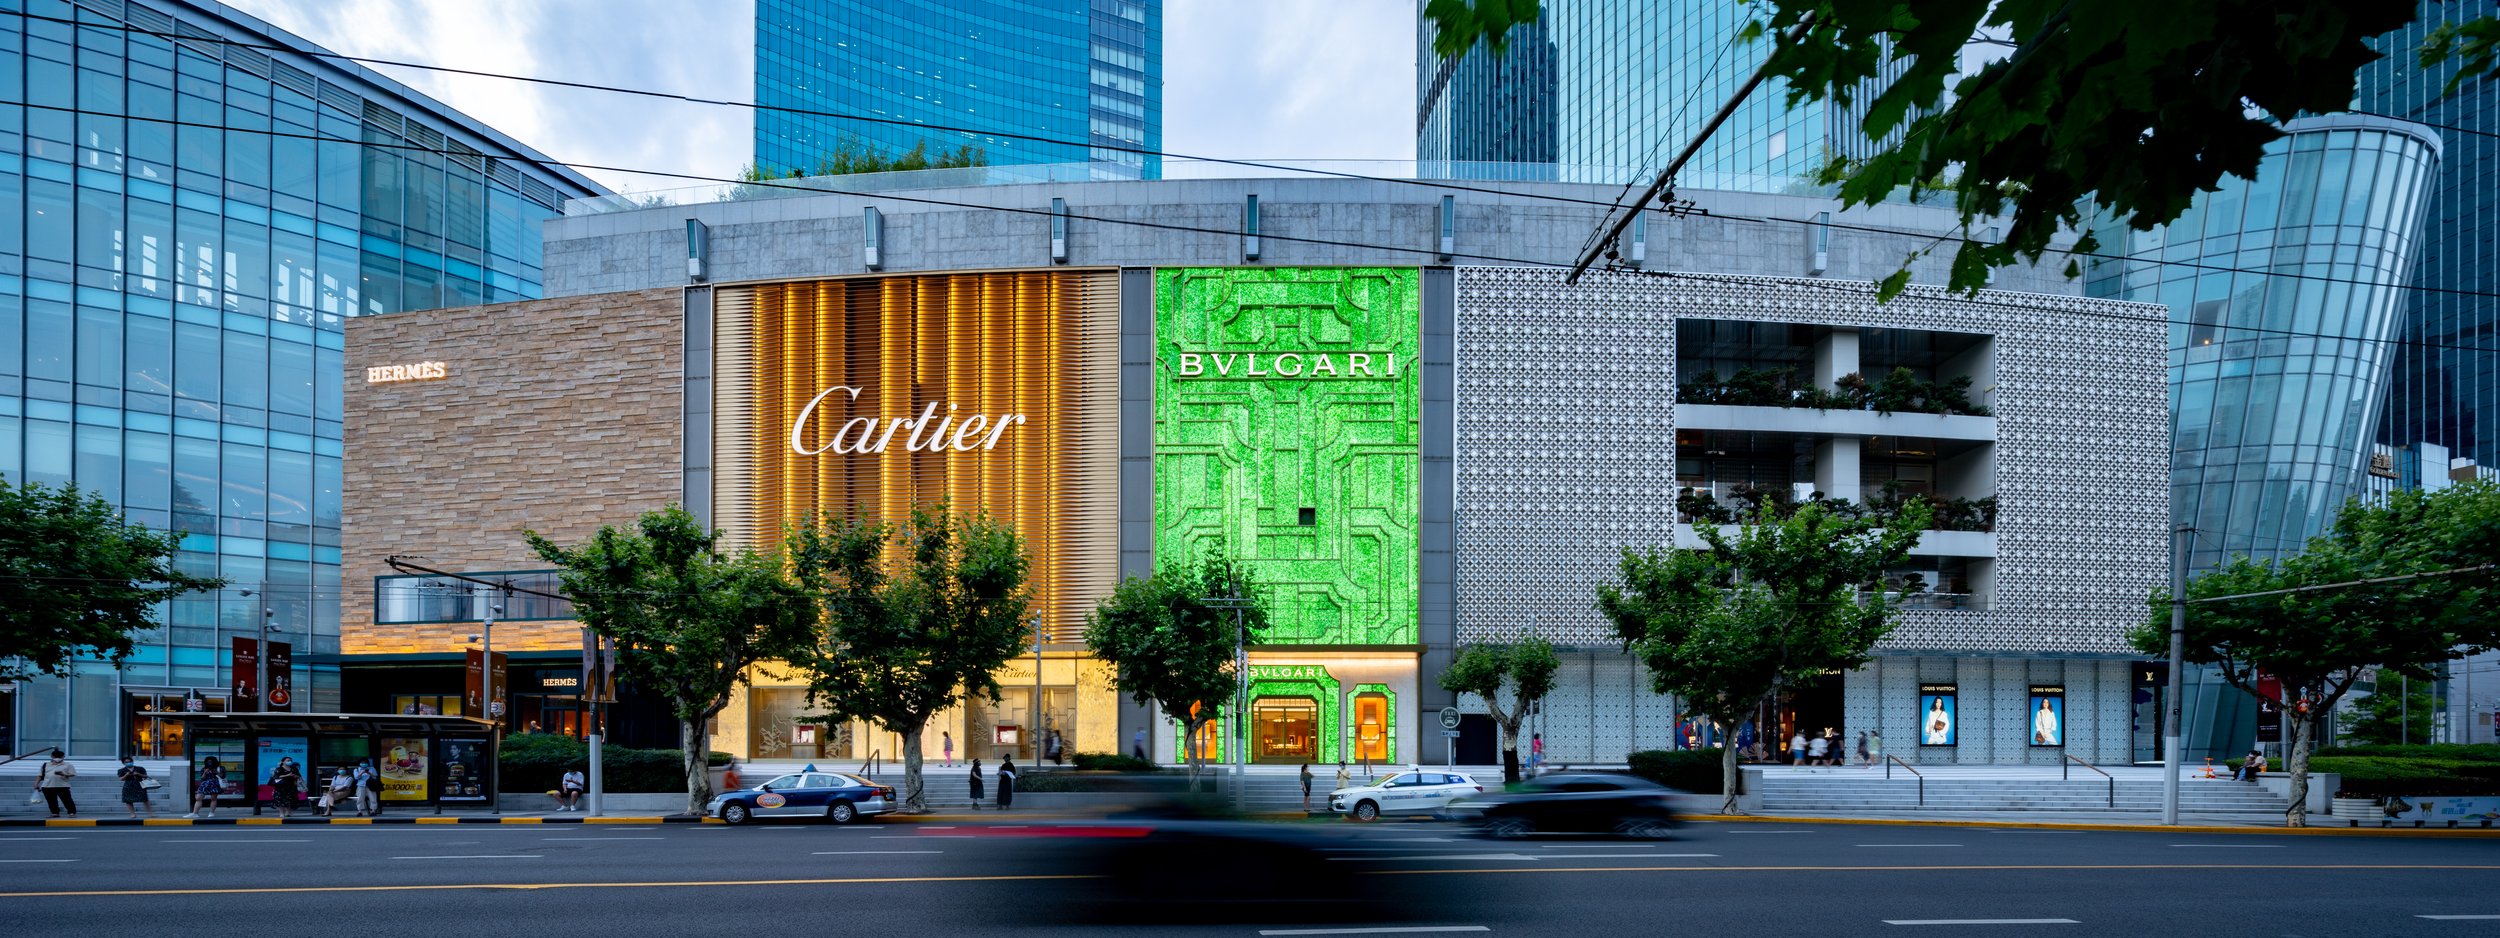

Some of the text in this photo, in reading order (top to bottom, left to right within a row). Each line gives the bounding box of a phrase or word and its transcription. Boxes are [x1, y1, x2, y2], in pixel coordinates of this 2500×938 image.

[367, 361, 446, 383] HERMÈS
[1179, 353, 1395, 377] BVLGARI
[791, 385, 1027, 455] Cartier
[1003, 669, 1037, 678] Cartier
[1250, 668, 1322, 677] BVLGARI
